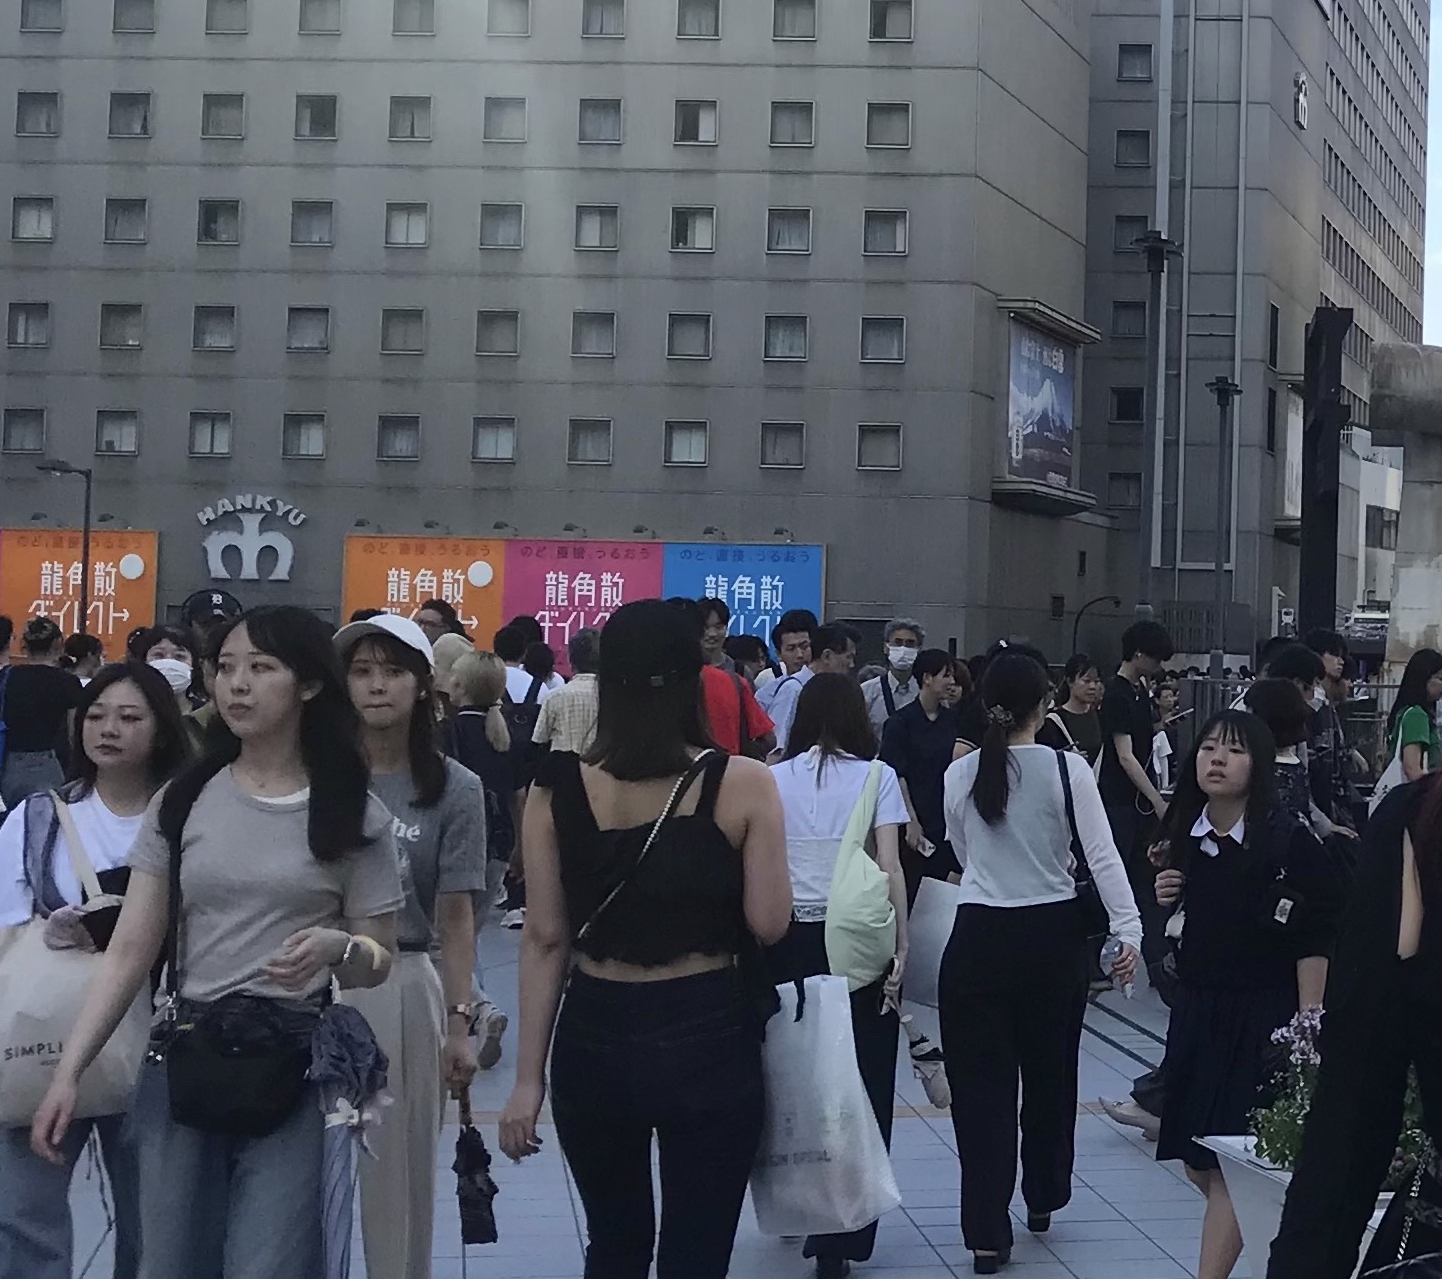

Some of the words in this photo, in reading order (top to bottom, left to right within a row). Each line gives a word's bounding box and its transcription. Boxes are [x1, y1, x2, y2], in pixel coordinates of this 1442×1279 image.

[197, 493, 307, 526] HANKYU
[40, 561, 117, 596] 龍角散
[387, 567, 465, 604] 龍角散
[545, 571, 625, 607] 龍角散
[705, 574, 785, 610] 龍角散
